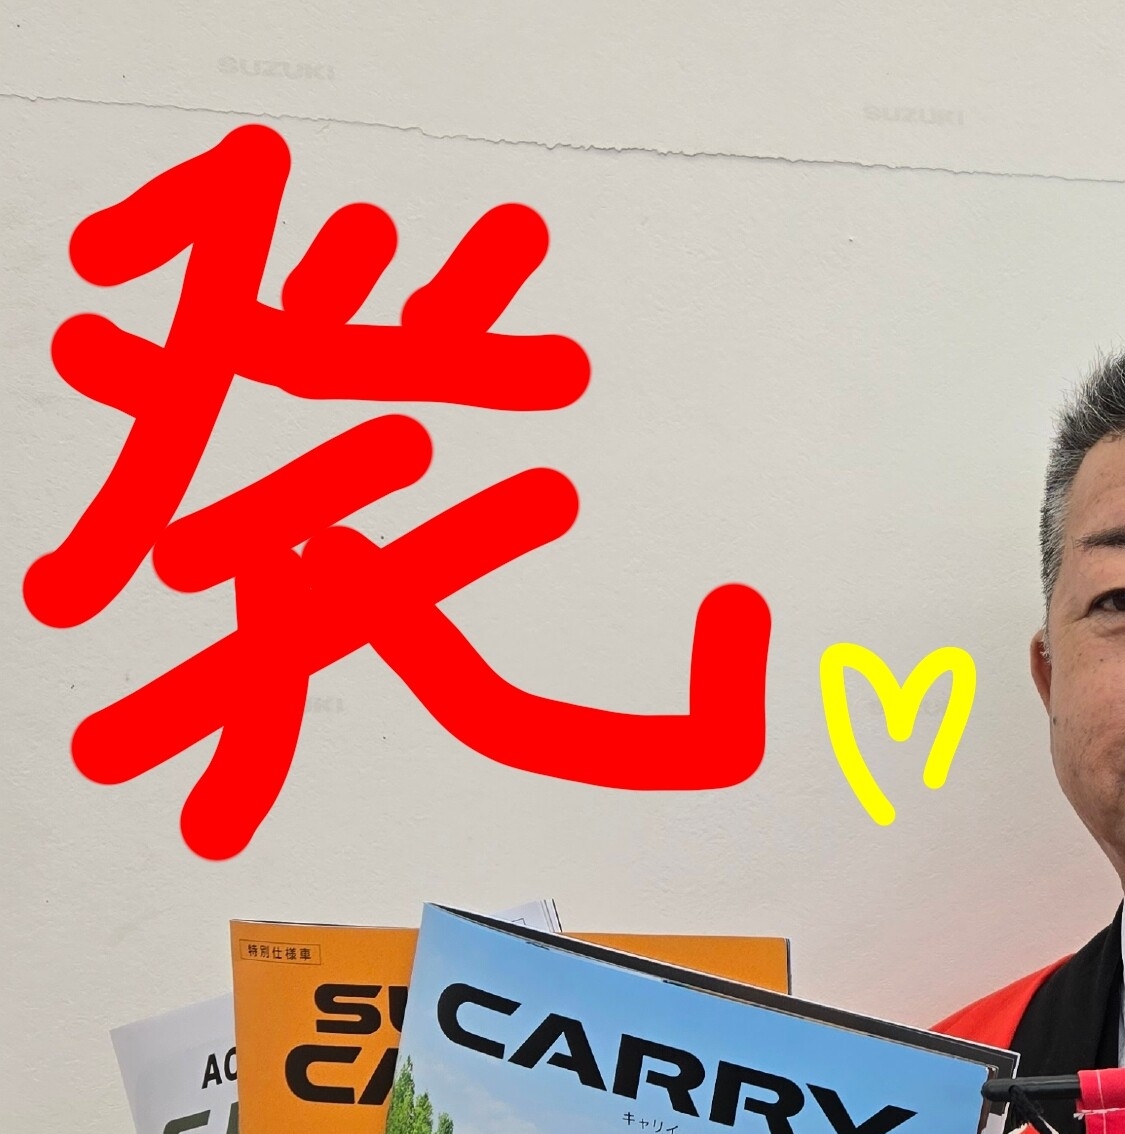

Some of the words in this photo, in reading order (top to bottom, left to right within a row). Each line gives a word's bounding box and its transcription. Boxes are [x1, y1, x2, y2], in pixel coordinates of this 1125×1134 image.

[216, 56, 335, 80] SUZUKI
[863, 105, 964, 126] SUZUKI
[247, 944, 312, 960] 特別仕様車
